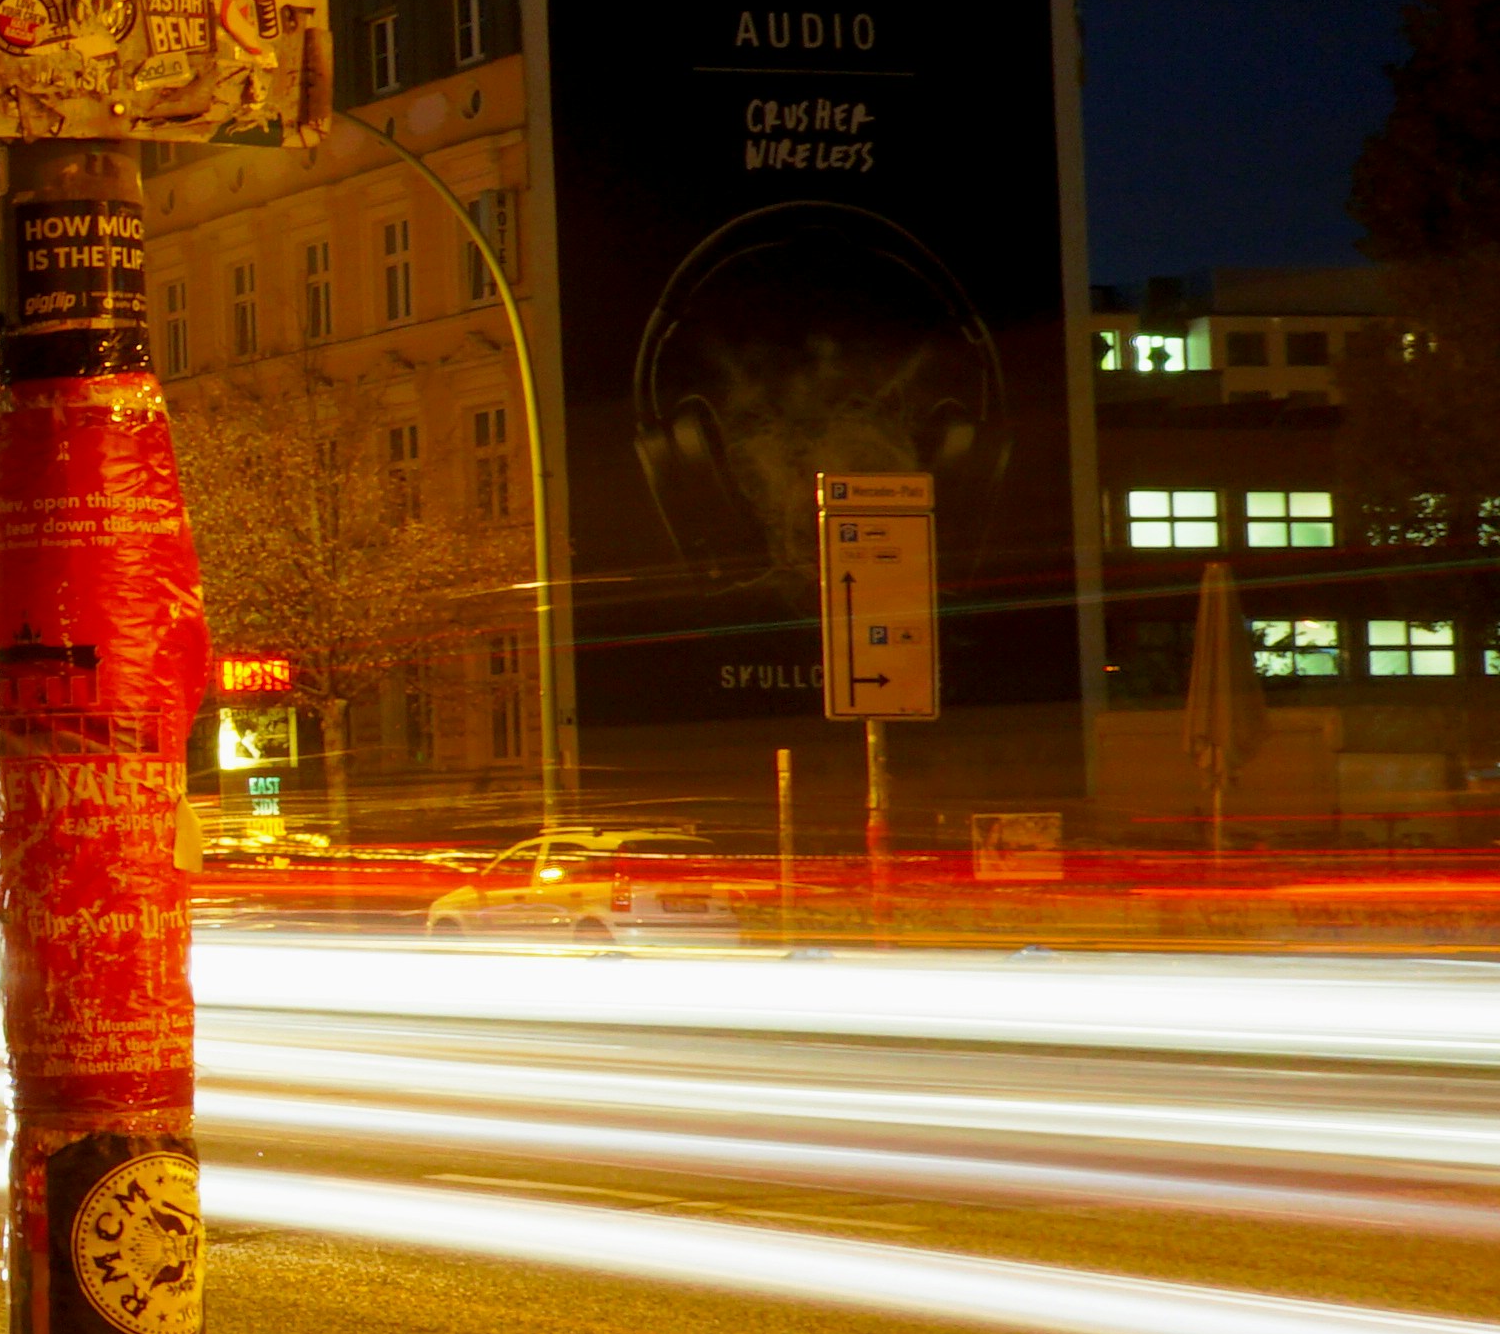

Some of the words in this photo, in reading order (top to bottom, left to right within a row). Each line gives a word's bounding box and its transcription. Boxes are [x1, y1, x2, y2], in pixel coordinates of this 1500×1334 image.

[150, 16, 206, 53] BENE
[734, 11, 878, 51] AUDIO
[745, 98, 876, 137] CRUSHER
[745, 139, 875, 171] WIRELESS
[25, 215, 92, 241] HOW
[28, 249, 49, 271] IS
[54, 245, 105, 269] THE
[33, 494, 80, 514] open
[86, 491, 120, 509] this
[43, 517, 97, 534] down
[249, 777, 281, 795] EAST
[251, 798, 281, 815] SIDE
